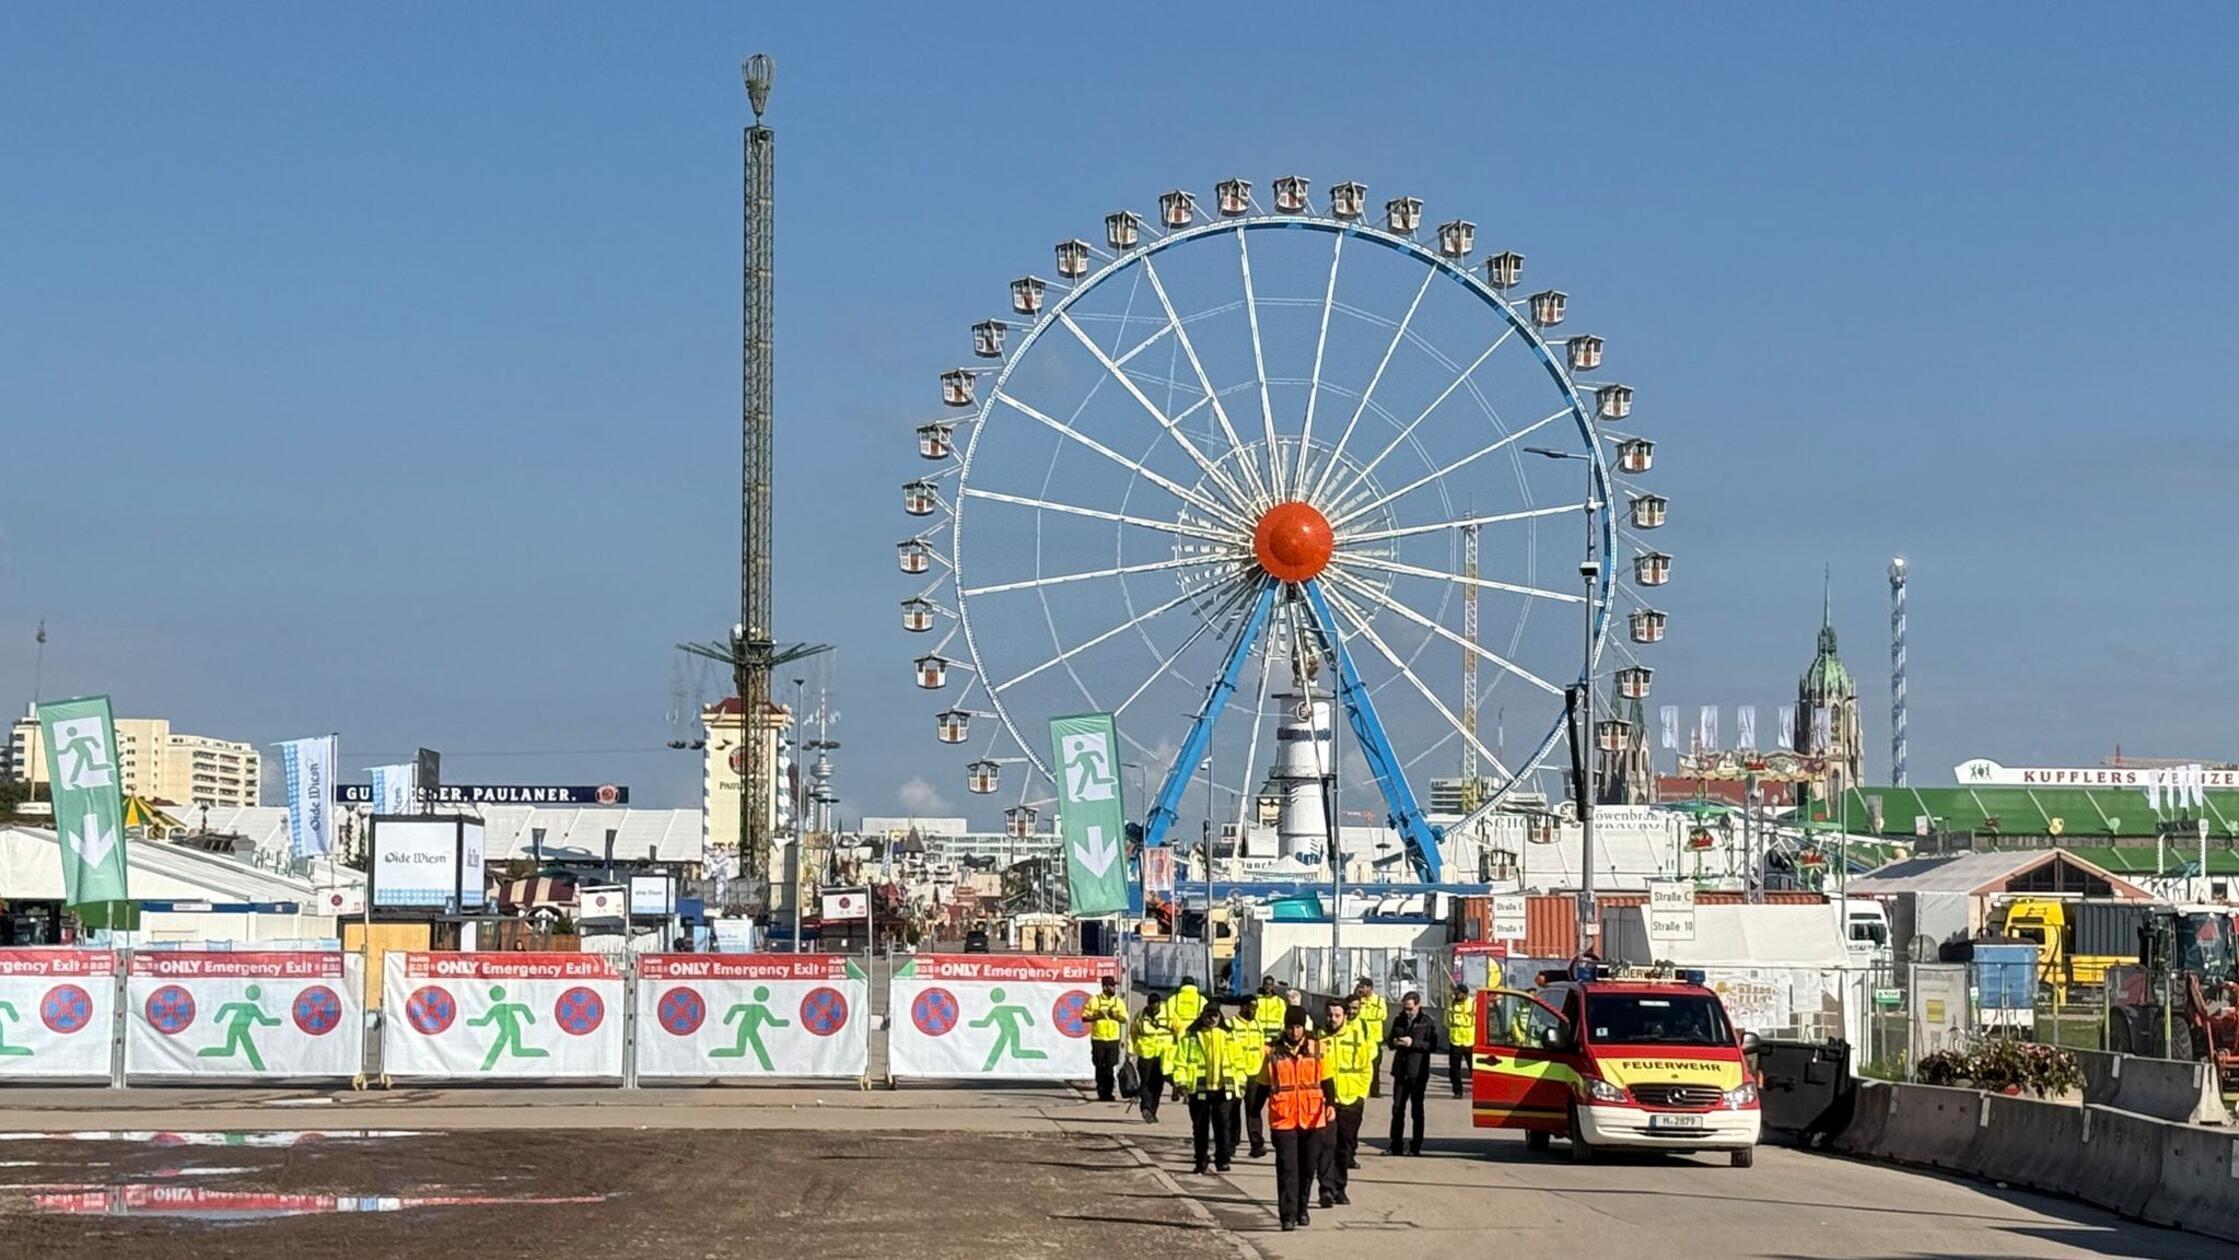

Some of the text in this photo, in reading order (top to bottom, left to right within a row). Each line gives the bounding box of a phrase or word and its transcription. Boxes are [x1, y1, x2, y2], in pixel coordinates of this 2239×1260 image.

[2024, 771, 2136, 783] KUFFLERS
[473, 788, 576, 801] PAULANER.
[1654, 891, 1691, 902] Straße C
[1653, 921, 1693, 931] Straße 10
[53, 959, 80, 972] Exit
[160, 961, 201, 973] ONLY
[204, 961, 282, 976] Emergency
[286, 960, 313, 972] Exit
[436, 960, 479, 974] ONLY
[482, 962, 562, 977] Emergency
[566, 961, 592, 974] Exit
[669, 962, 710, 975] ONLY
[713, 963, 789, 978] Emergency
[794, 962, 818, 975] Exit
[940, 963, 981, 977] ONLY
[983, 964, 1059, 980] Emergency
[1063, 964, 1089, 977] Exit
[1622, 1061, 1722, 1072] FEUERWEHR
